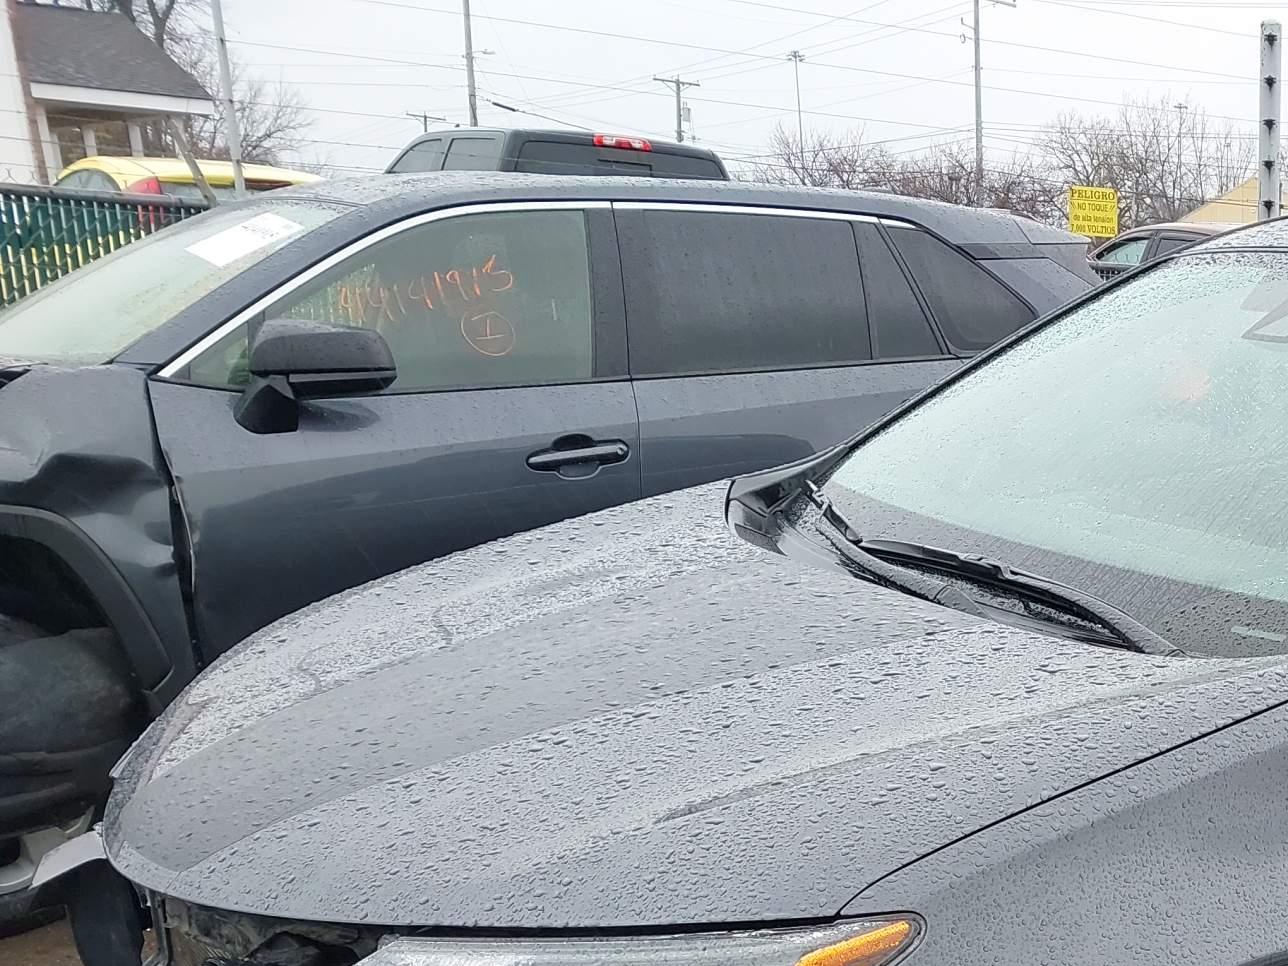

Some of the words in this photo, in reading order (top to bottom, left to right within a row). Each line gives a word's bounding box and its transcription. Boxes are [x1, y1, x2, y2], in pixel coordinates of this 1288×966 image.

[1071, 189, 1115, 200] PELIGRO
[1077, 203, 1086, 211] NO
[1088, 203, 1109, 212] TOQUE
[1088, 225, 1115, 234] VOLTIOS
